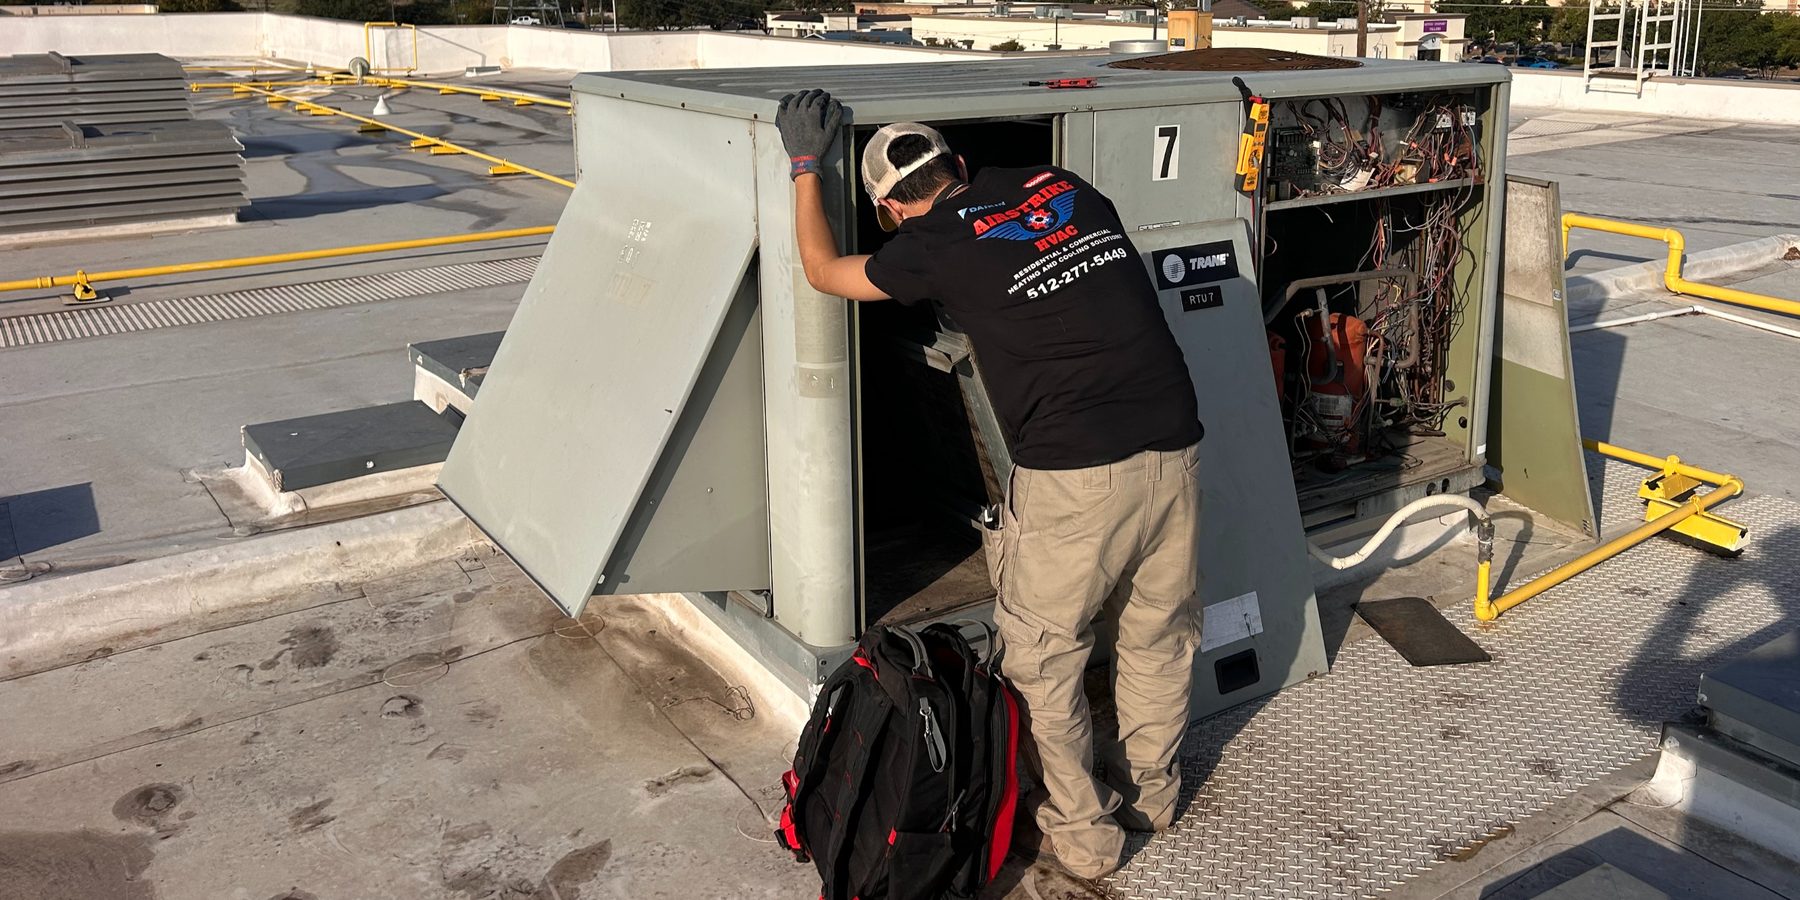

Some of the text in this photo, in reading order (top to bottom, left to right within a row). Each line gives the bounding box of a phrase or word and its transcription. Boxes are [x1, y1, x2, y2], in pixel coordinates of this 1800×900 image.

[1158, 126, 1178, 178] 7
[973, 181, 1074, 236] AIRSTRIKE
[1013, 250, 1062, 280] RESIDENTIAL
[1068, 228, 1112, 249] COMMERCIAL
[1034, 225, 1079, 252] HVAC
[1189, 253, 1226, 270] TRANE
[1007, 271, 1041, 295] HEATING
[1042, 260, 1058, 273] AND
[1058, 245, 1090, 263] COOLING
[1026, 247, 1127, 300] 512-277-5449
